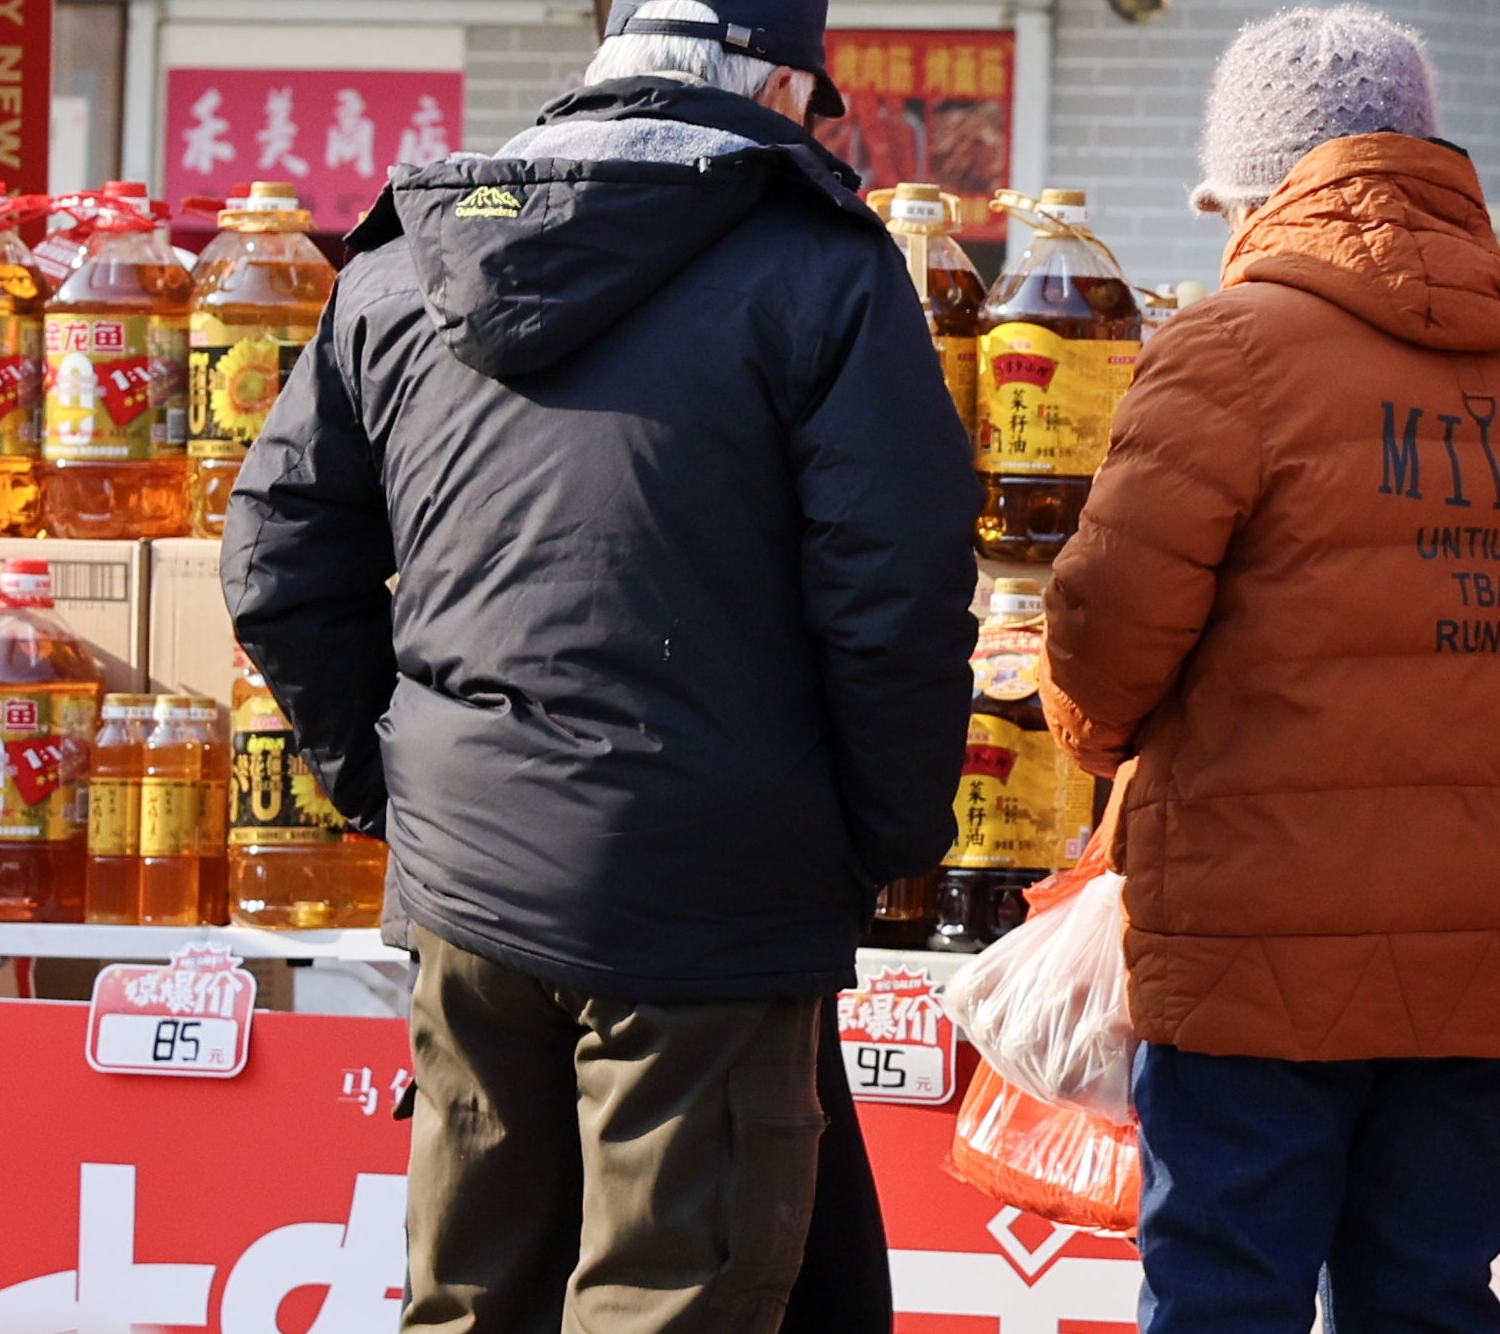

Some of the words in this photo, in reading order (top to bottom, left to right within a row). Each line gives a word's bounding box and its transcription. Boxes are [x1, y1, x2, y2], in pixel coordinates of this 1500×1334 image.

[44, 319, 126, 354] 金龙鱼
[1008, 387, 1029, 455] 菜籽油
[965, 780, 987, 848] 菜籽油
[122, 968, 244, 1019] 惊爆价
[151, 1019, 202, 1063] 85
[208, 1047, 225, 1064] 元
[857, 1045, 907, 1088] 95
[915, 1076, 932, 1092] 元
